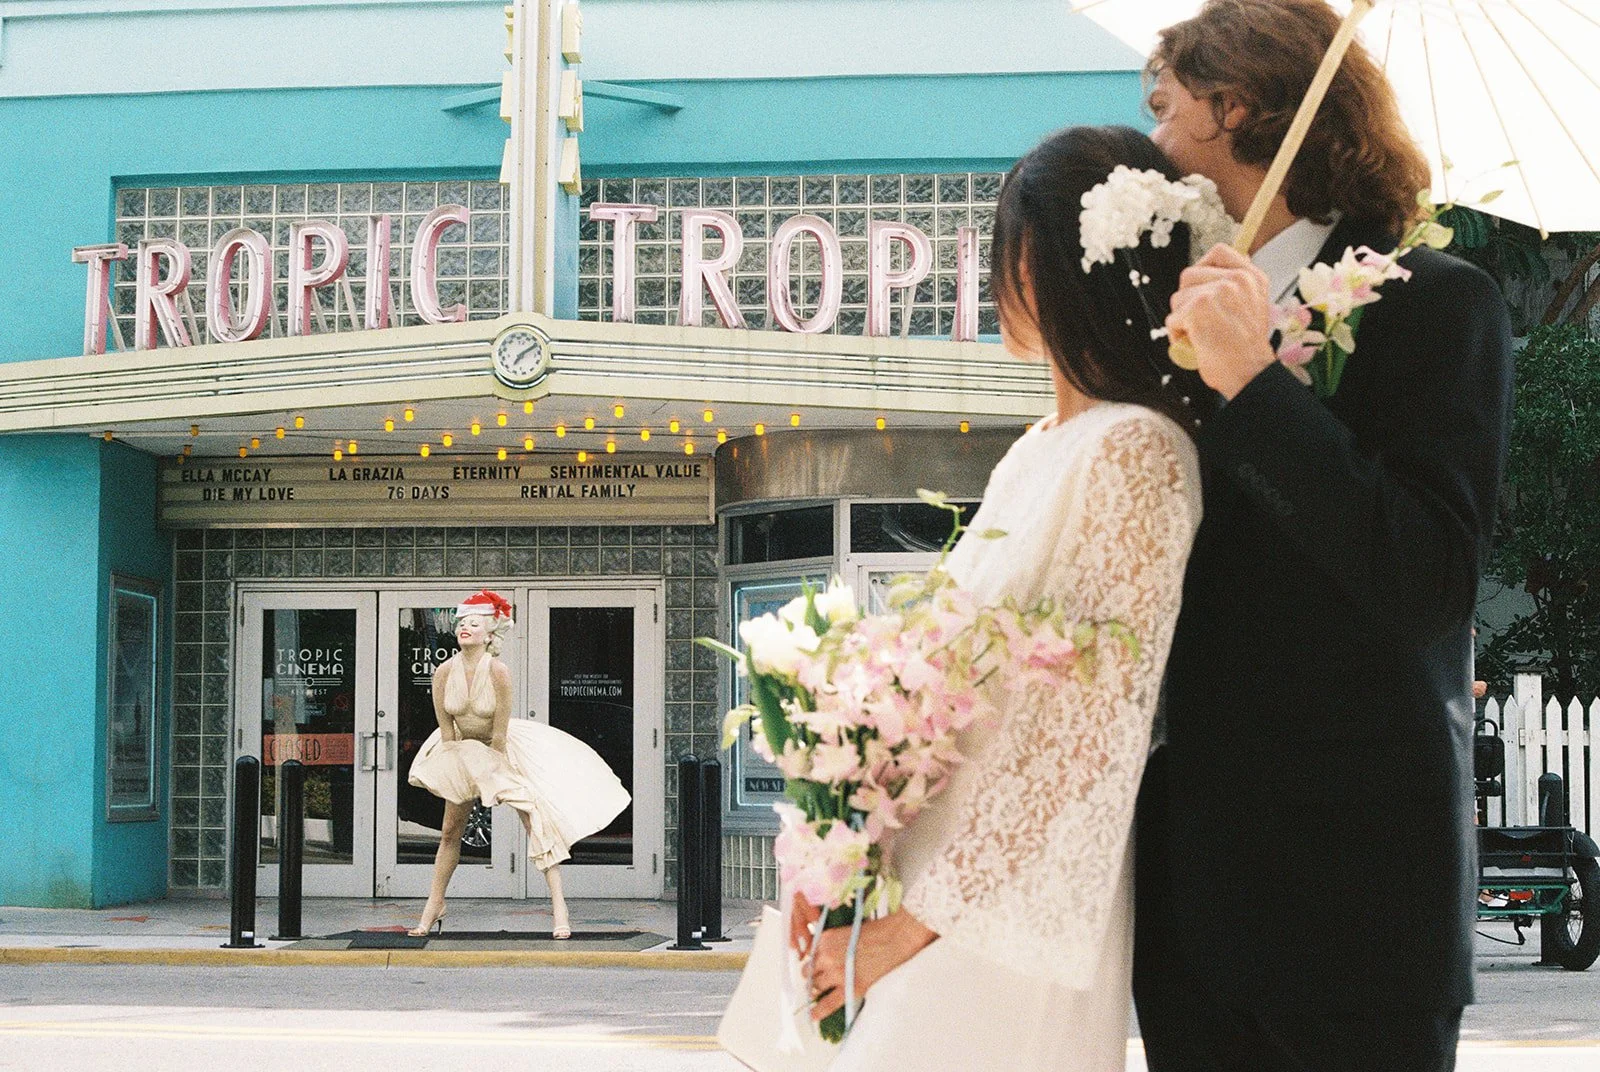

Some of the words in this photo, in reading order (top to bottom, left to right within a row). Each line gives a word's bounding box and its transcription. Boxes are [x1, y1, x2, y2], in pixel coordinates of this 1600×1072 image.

[72, 204, 470, 355] TROPIC
[590, 202, 980, 342] TROPI
[182, 469, 214, 482] ELLA
[222, 468, 271, 482] MCCAY
[329, 468, 347, 481] LA
[353, 467, 404, 481] GRAZIA
[453, 465, 521, 480] ETERNITY
[550, 464, 649, 479] SENTIMENTAL
[655, 463, 701, 478] VALUE
[203, 487, 225, 501] DIE
[233, 487, 251, 500] MY
[259, 486, 294, 500] LOVE
[388, 486, 405, 500] 76
[412, 485, 450, 500] DAYS
[521, 484, 575, 499] RENTAL
[581, 483, 636, 498] FAMILY
[276, 648, 343, 662] TROPIC
[412, 647, 459, 661] TROP
[276, 662, 344, 675] CINEMA
[560, 686, 622, 697] TROPICCINEMA.COM
[269, 739, 321, 761] CLOSED
